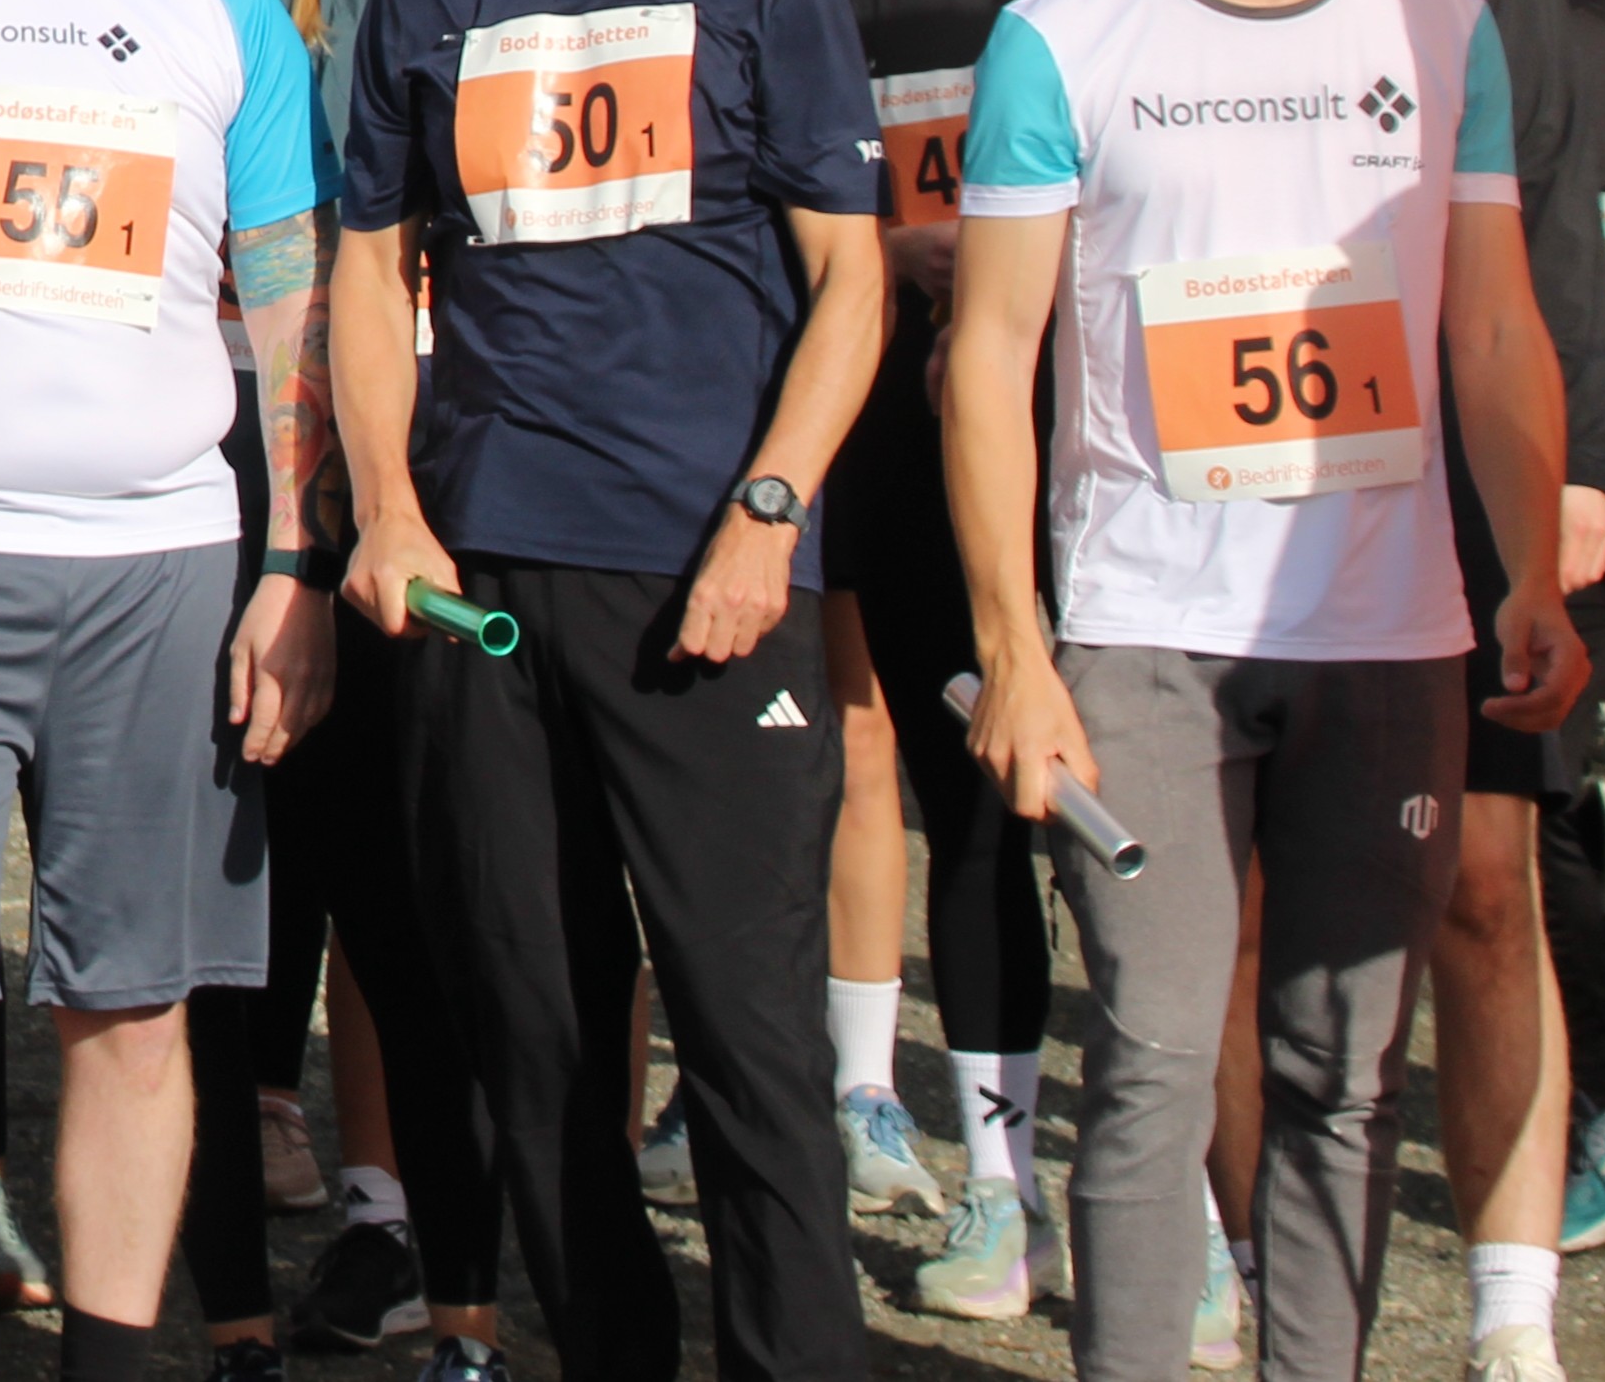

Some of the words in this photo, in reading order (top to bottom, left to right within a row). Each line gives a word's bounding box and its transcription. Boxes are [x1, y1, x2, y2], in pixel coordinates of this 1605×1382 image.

[530, 82, 618, 174] 50
[641, 121, 655, 158] 1
[1131, 83, 1348, 131] Norconsult
[916, 129, 968, 205] 4
[1352, 154, 1411, 169] CRAFT
[120, 219, 135, 256] 1
[1185, 267, 1353, 299] Bodøstafetten
[1232, 328, 1339, 427] 56
[1363, 375, 1382, 415] 1
[1239, 457, 1385, 486] Bedriftsidretten
